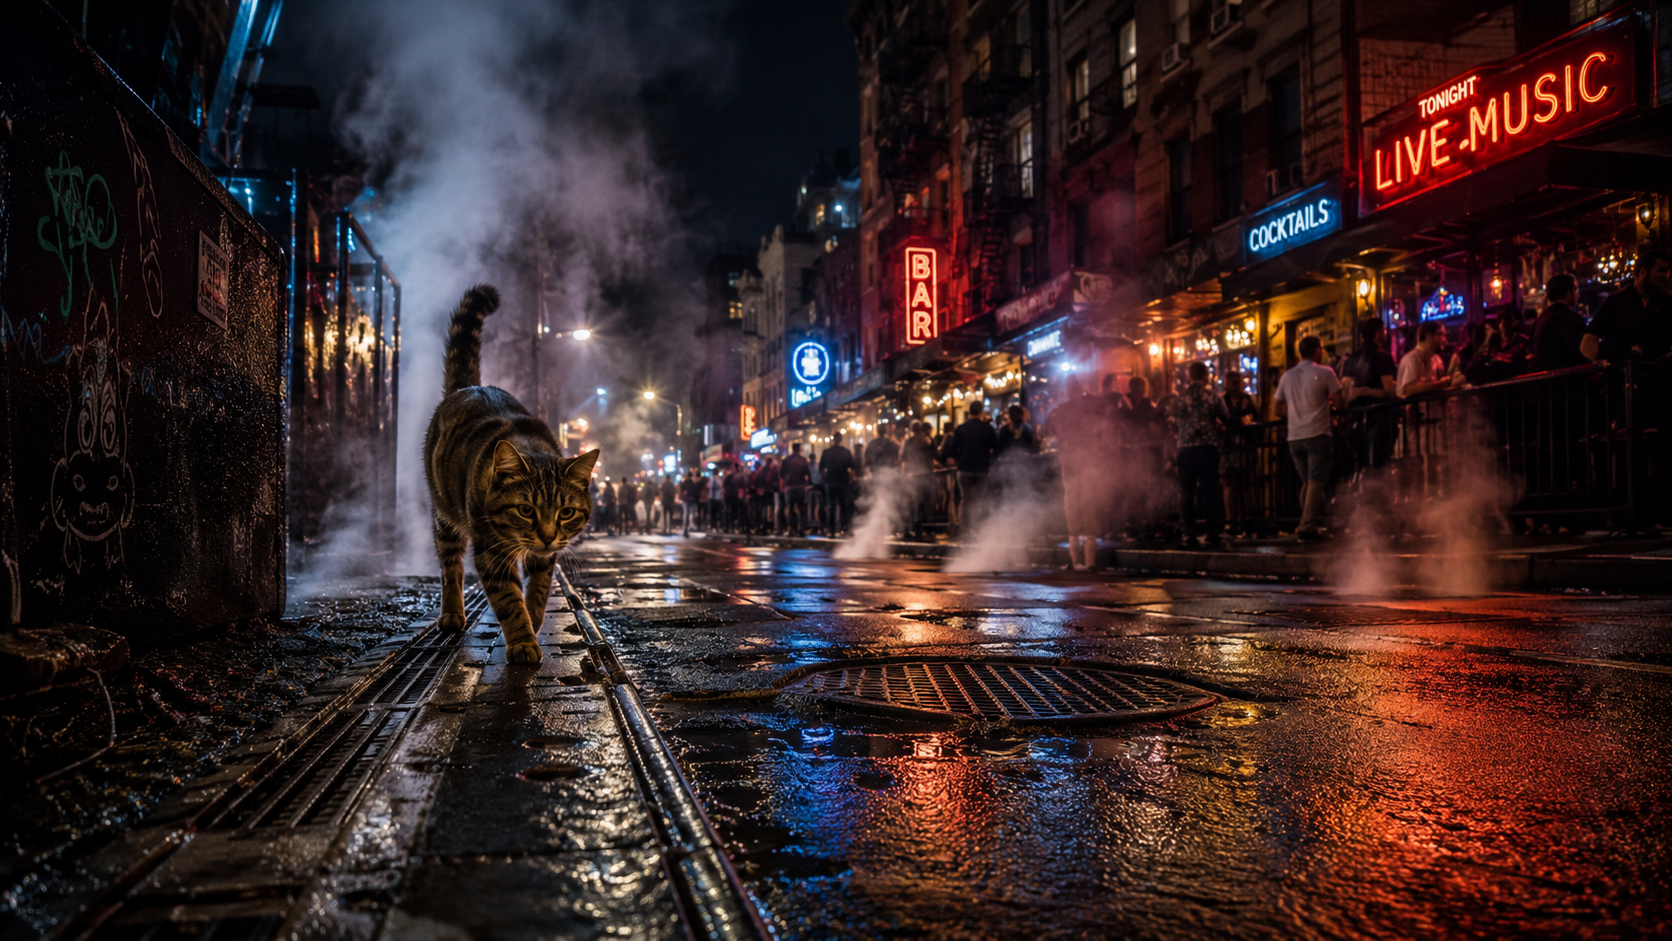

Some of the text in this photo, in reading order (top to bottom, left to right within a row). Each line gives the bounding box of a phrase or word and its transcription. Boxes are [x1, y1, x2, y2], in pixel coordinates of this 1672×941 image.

[1418, 75, 1477, 118] TONIGHT
[1375, 118, 1450, 191] LIVE
[1248, 198, 1330, 252] COCKTAILS
[911, 253, 933, 339] BAR
